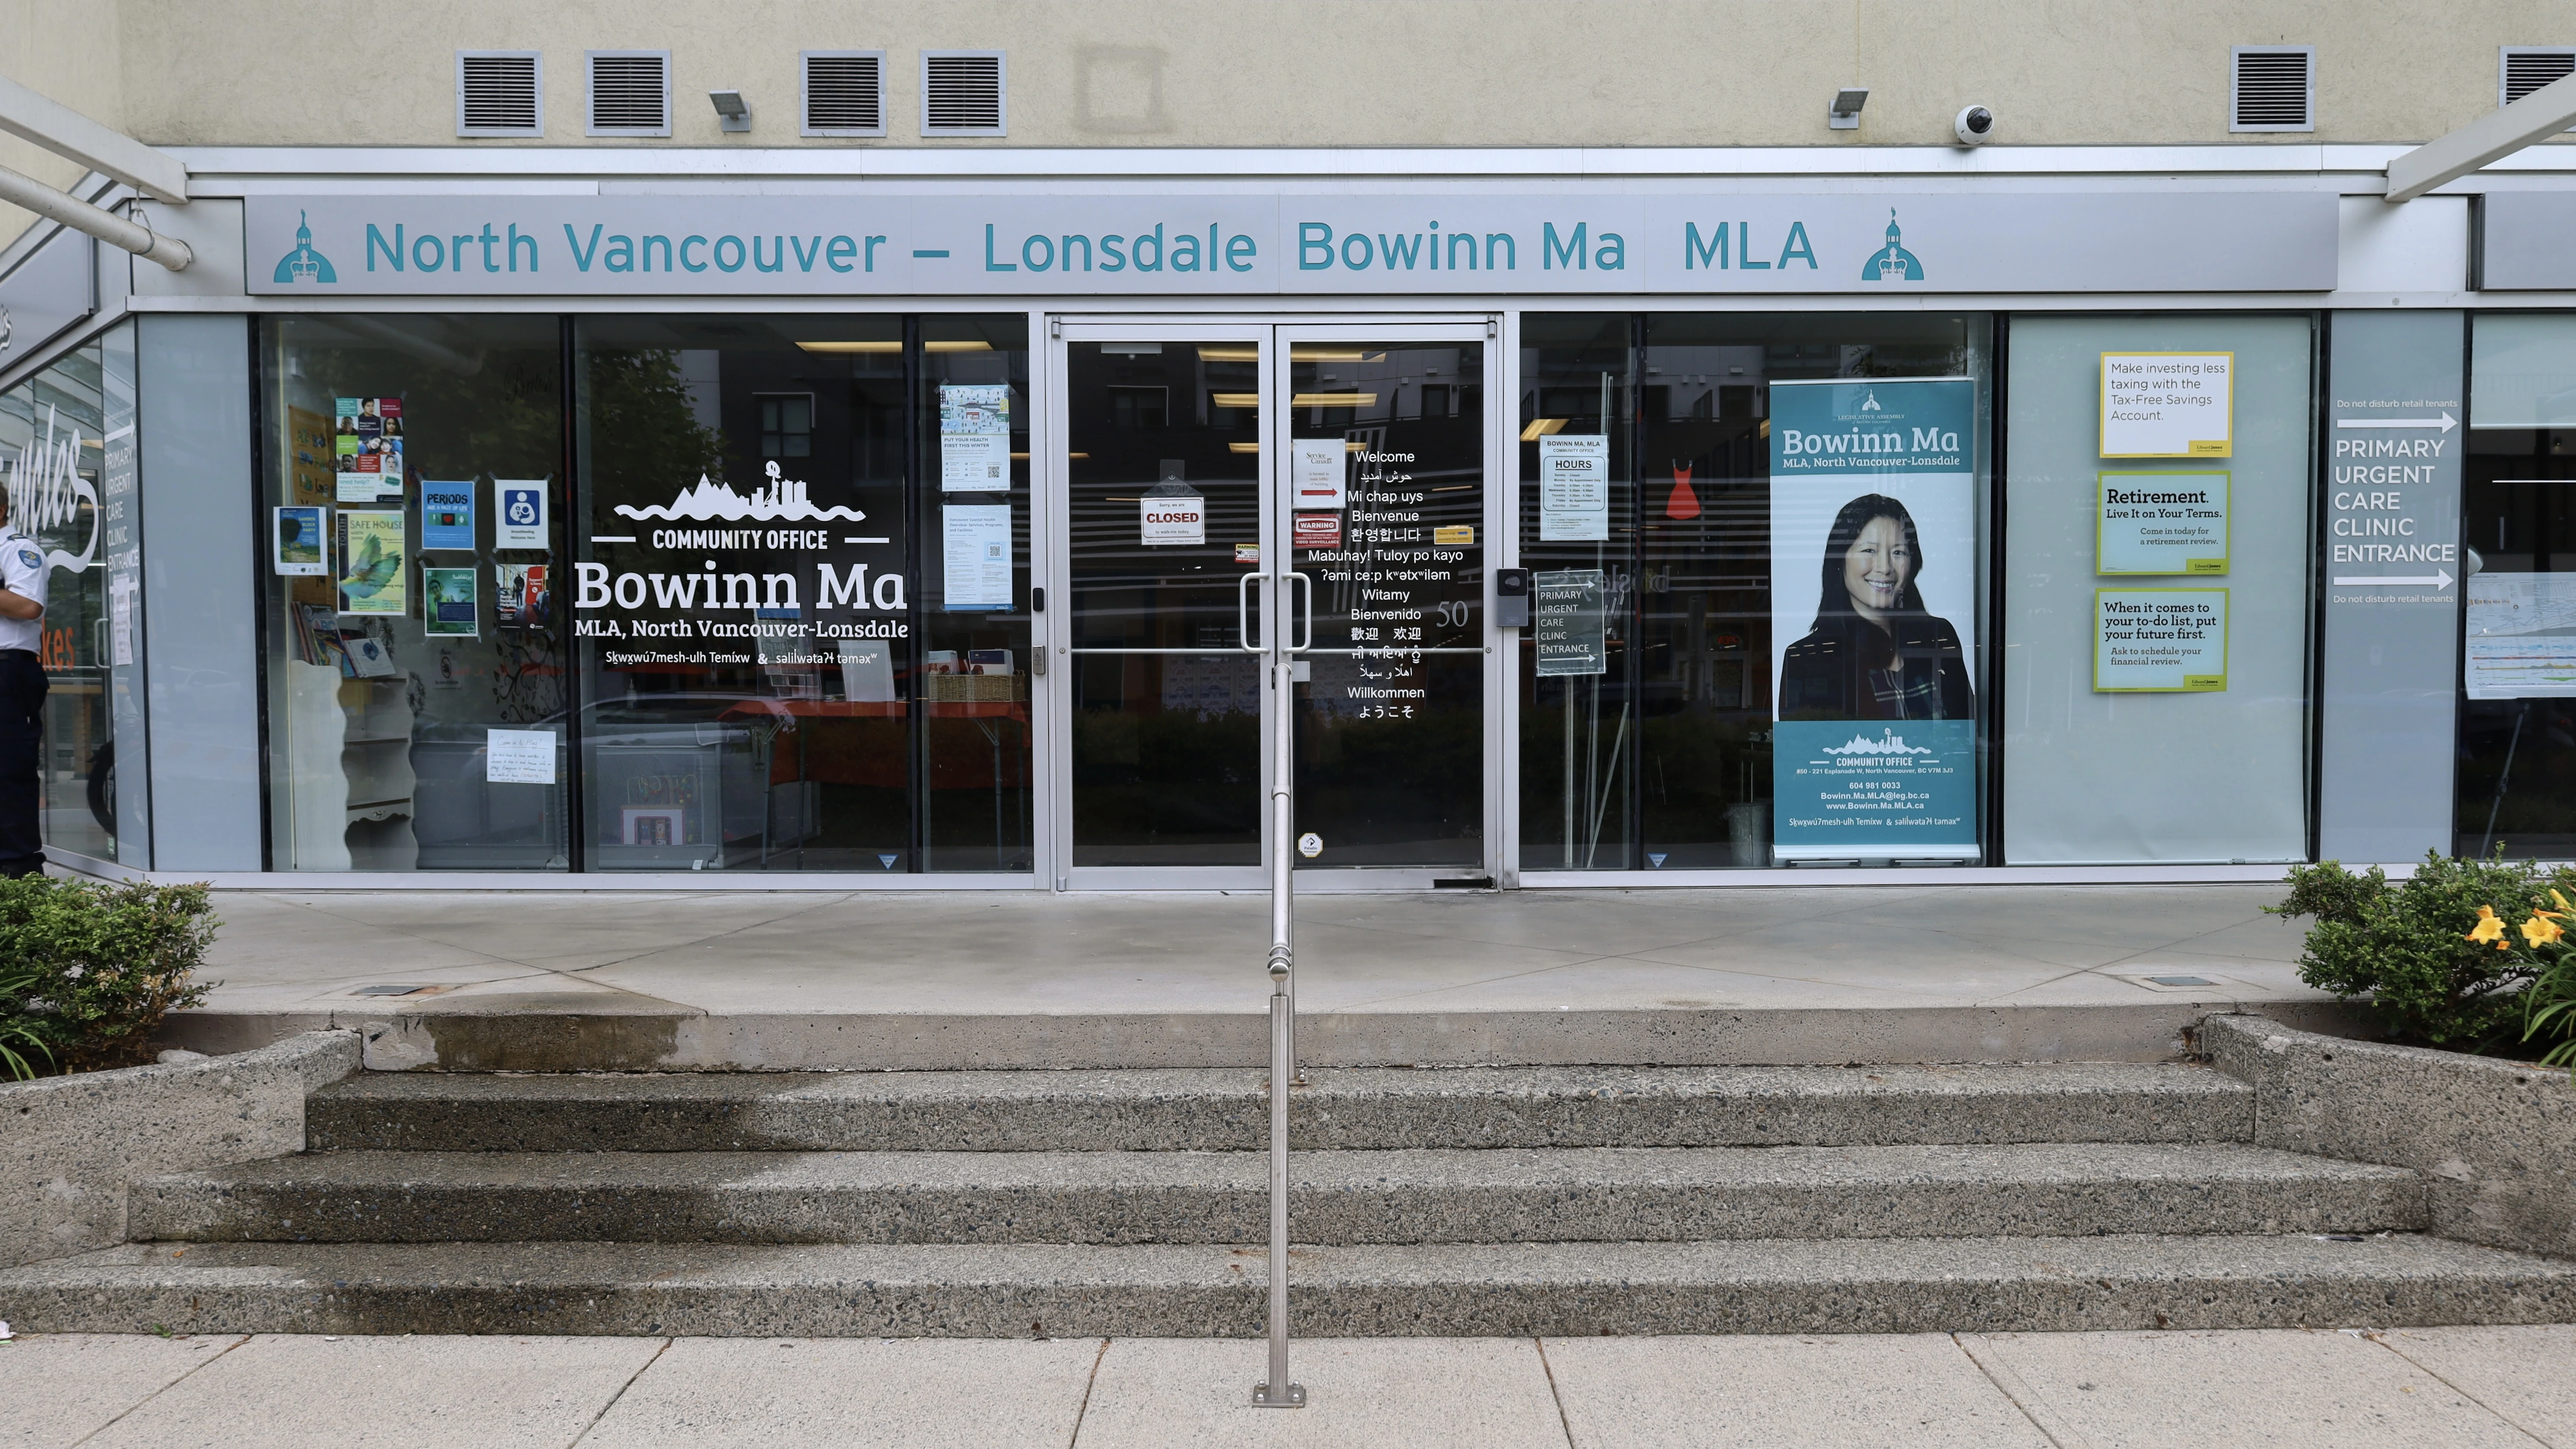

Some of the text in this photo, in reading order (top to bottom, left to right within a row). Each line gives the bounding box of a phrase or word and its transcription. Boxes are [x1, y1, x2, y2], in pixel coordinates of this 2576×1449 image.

[367, 221, 1817, 273] North Vancouver Lonsdale Bowinn Ma MLA
[2112, 363, 2225, 375] Make investing less
[2111, 379, 2200, 390] taxing with the
[2112, 394, 2212, 406] Tax-Free Savings
[2369, 400, 2399, 408] disturb
[2111, 411, 2164, 421] Account.
[1783, 427, 1959, 455] Bowinn Ma
[2336, 440, 2445, 458] PRIMARY
[105, 446, 133, 471] PRIMARY
[1355, 451, 1415, 462] Welcome
[1783, 456, 1960, 469] MLA, North Vancouver-Lonsdale
[2335, 466, 2435, 484] URGENT
[106, 473, 131, 497] URGENT
[1348, 491, 1423, 504] Mi chap uys
[2107, 489, 2209, 503] Retirement.
[2334, 492, 2401, 510] CARE
[106, 501, 124, 522] CARE
[1147, 513, 1198, 523] CLOSED
[1353, 511, 1419, 521] Bienvenue
[2107, 509, 2128, 518] Live
[2132, 509, 2140, 518] It
[2158, 509, 2183, 517] Your
[2186, 509, 2222, 517] Terms.
[350, 521, 403, 529] SAFE HOUSE
[2175, 527, 2196, 536] today
[2334, 518, 2414, 536] CLINIC
[107, 525, 127, 546] CLINIC
[653, 529, 828, 550] COMMUNITY OFFICE
[1351, 528, 1421, 542] 환영합니다
[1308, 549, 1463, 563] Mabuhay! Tuloy po kayo
[2334, 544, 2455, 562] ENTRANCE
[108, 549, 139, 572] ENTRANCE
[574, 559, 801, 610] Bowinn
[816, 563, 907, 610] Ma
[1362, 589, 1410, 602] Witamy
[1540, 591, 1582, 600] PRIMARY
[1436, 601, 1468, 627] 50
[1540, 604, 1578, 613] URGENT
[2104, 602, 2209, 613] When it comes to
[1351, 609, 1421, 620] Bienvenido
[1540, 619, 1563, 627] CARE
[2105, 615, 2216, 628] your to-do list, put
[575, 620, 908, 639] MLA, North Vancouver-Lonsdale
[1351, 627, 1421, 641] 歡迎 欢迎
[1540, 632, 1567, 640] CLINC
[2105, 628, 2206, 641] your future first.
[1541, 644, 1589, 654] ENTRANCE
[1348, 687, 1424, 698] Willkommen
[1360, 706, 1414, 718] ようこそ
[1836, 757, 1912, 766] COMMUNITY OFFICE
[1821, 792, 1929, 801] Bowinn.Ma.MLA@leg.bc.ca
